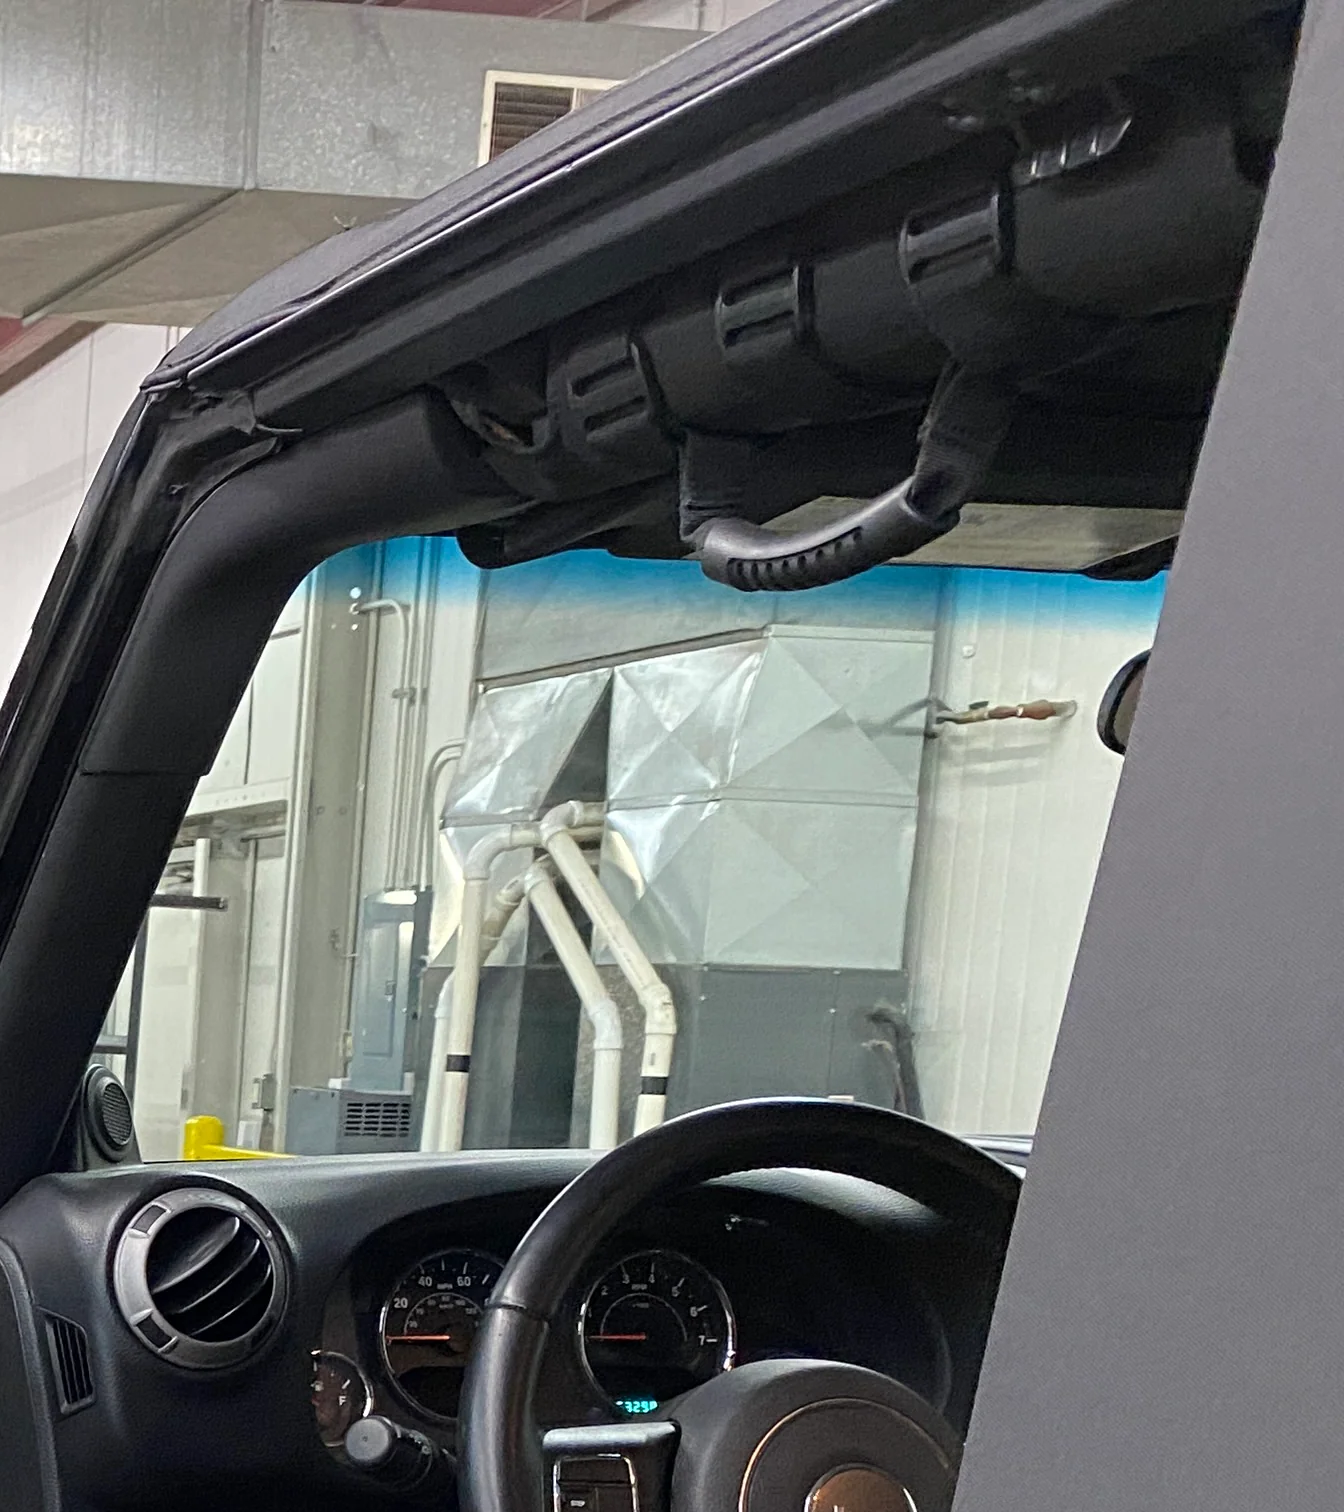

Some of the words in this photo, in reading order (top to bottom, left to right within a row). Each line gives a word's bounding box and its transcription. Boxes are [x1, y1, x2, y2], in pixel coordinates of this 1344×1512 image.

[418, 1276, 433, 1287] 40
[457, 1276, 472, 1287] 60
[601, 1286, 609, 1296] 2
[393, 1298, 409, 1309] 20
[690, 1307, 698, 1318] 6
[699, 1335, 706, 1346] 7
[338, 1395, 347, 1406] F
